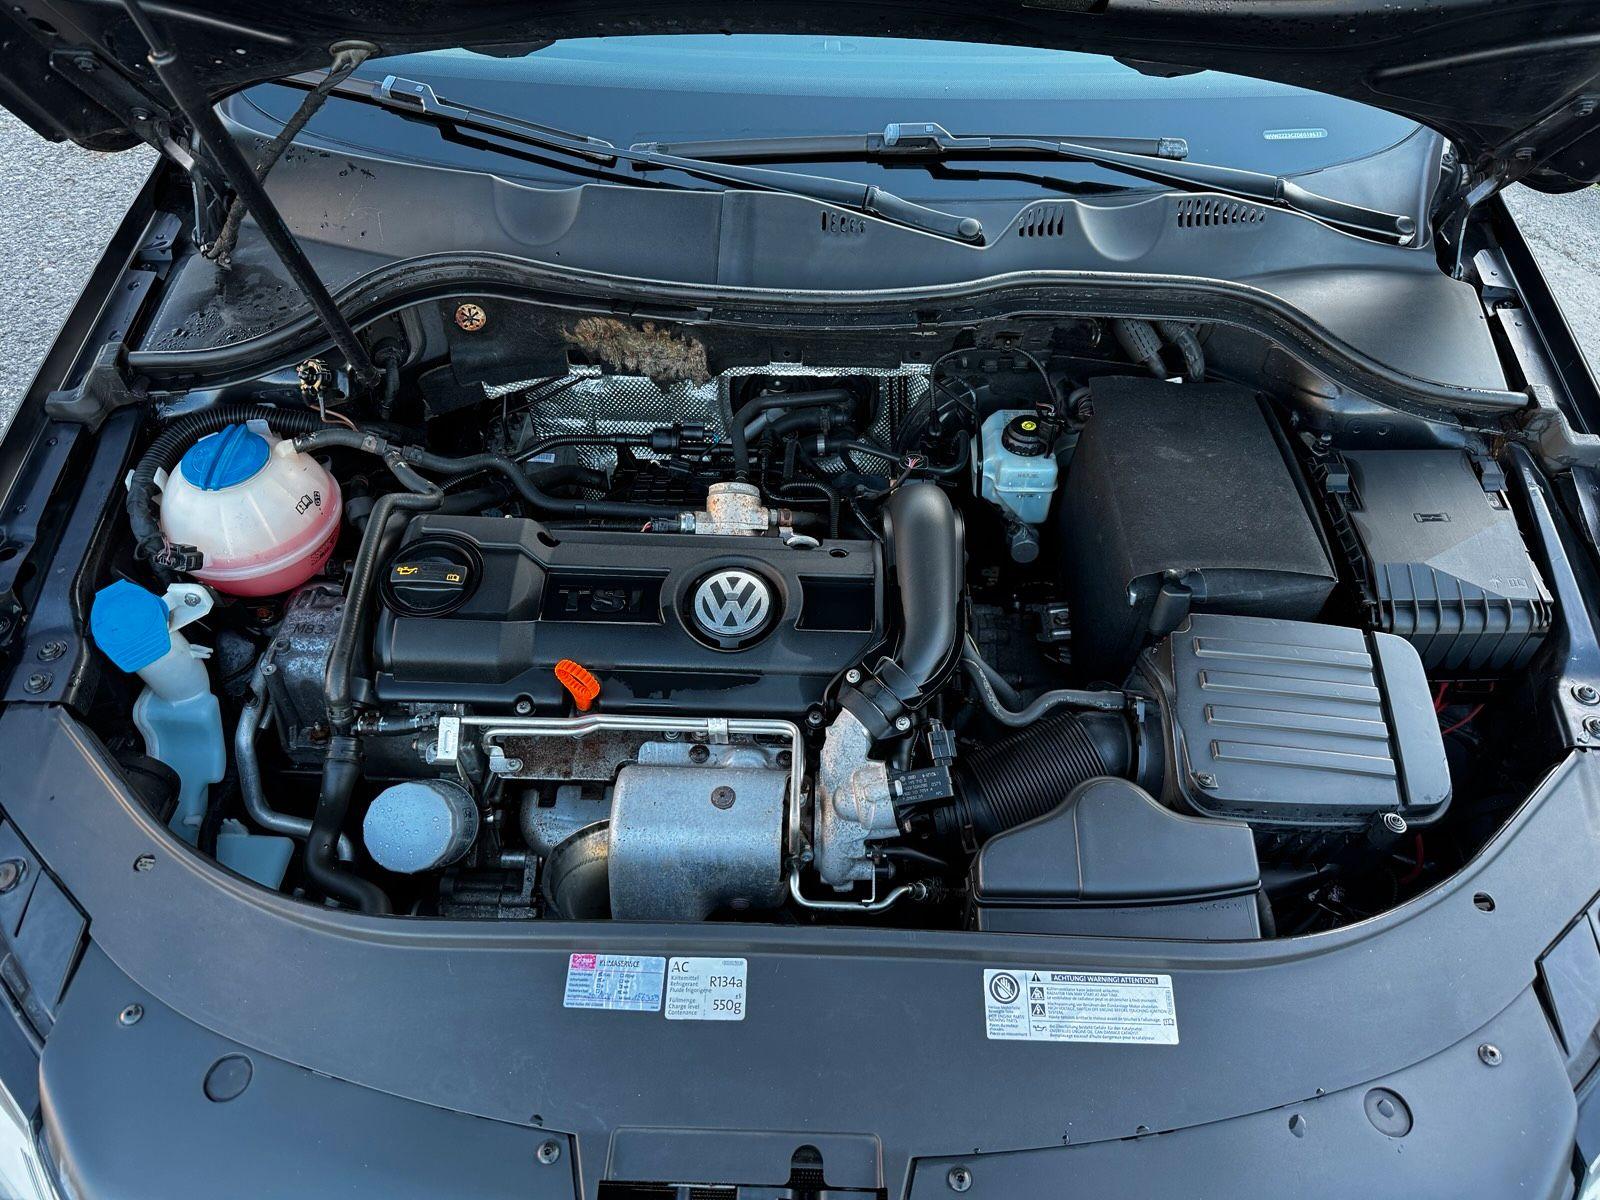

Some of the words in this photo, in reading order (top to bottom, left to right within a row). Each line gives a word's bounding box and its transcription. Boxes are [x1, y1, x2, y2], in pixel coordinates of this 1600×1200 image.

[672, 961, 689, 972] AC
[710, 976, 743, 988] R134a
[712, 1000, 742, 1014] 550g
